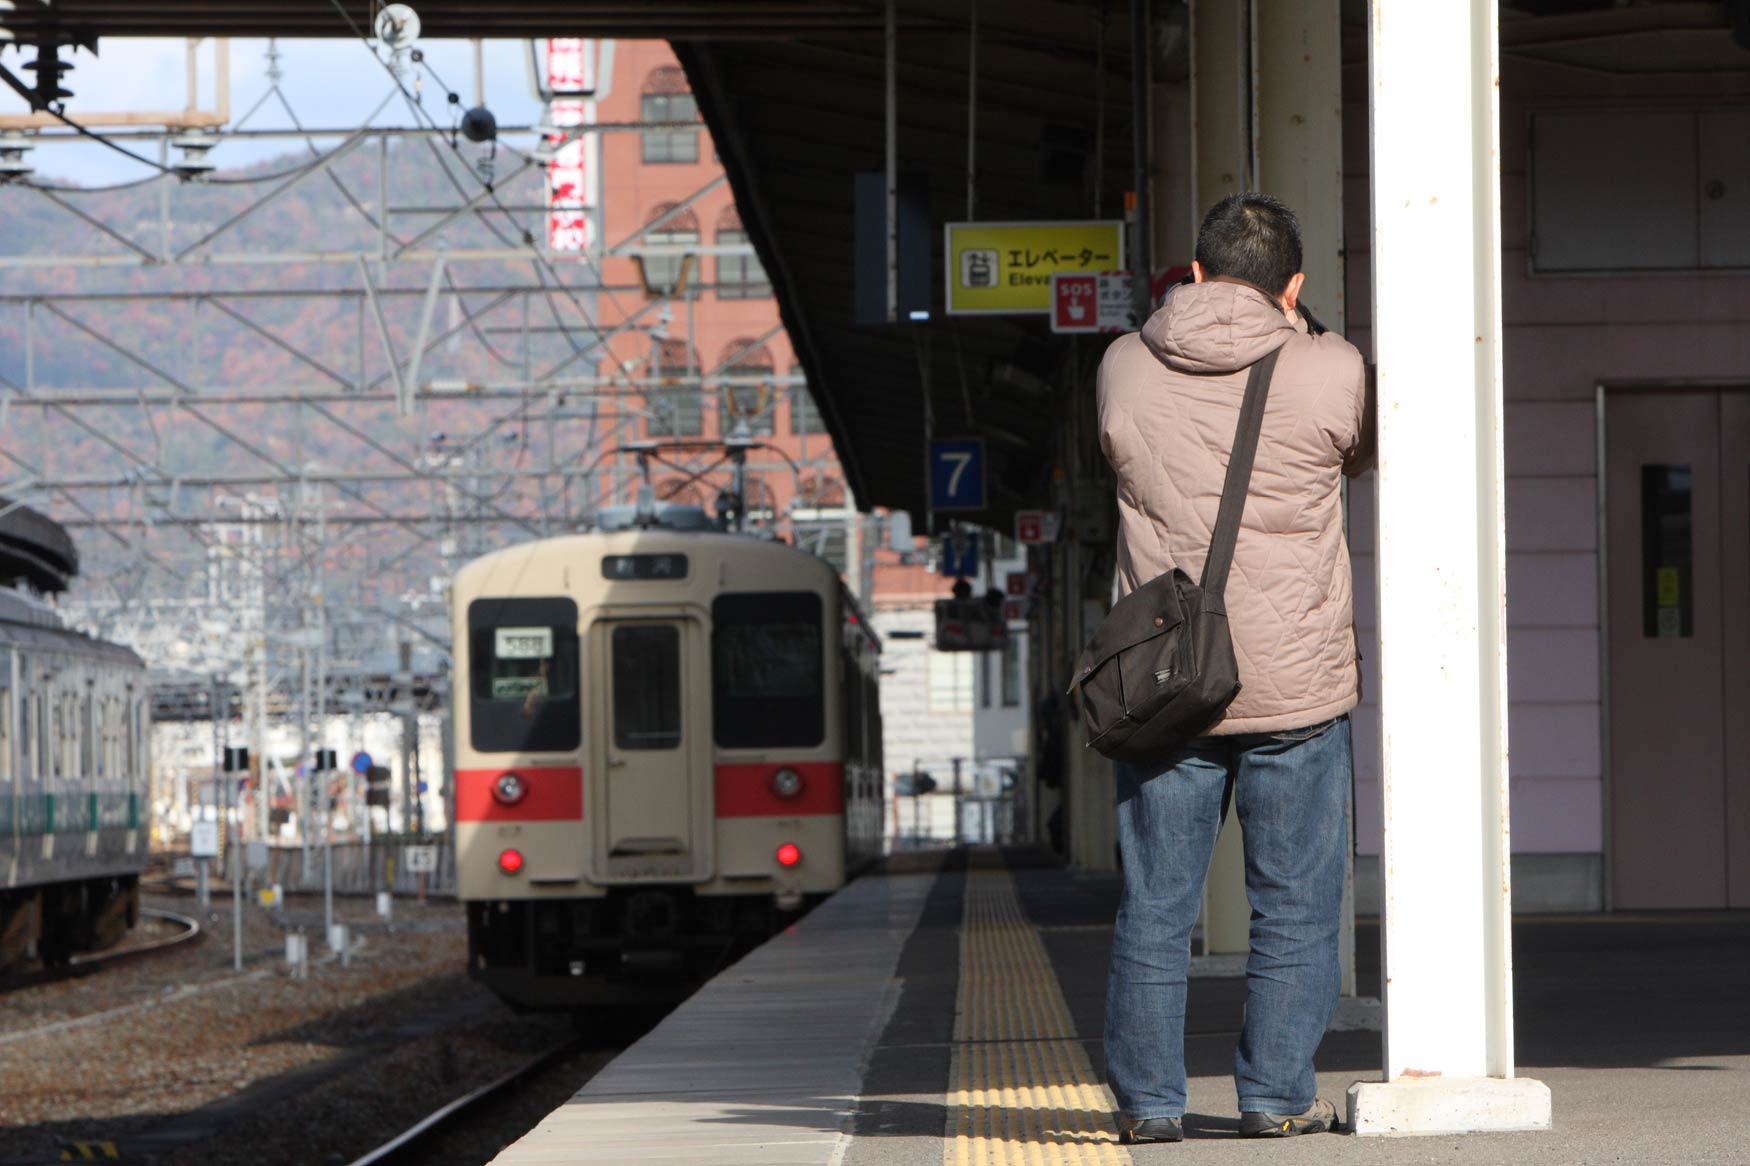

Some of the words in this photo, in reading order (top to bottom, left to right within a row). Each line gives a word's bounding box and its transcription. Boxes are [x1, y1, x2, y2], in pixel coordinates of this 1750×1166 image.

[1008, 248, 1110, 268] エレベーター
[1060, 283, 1092, 297] SOS
[940, 452, 972, 497] 7
